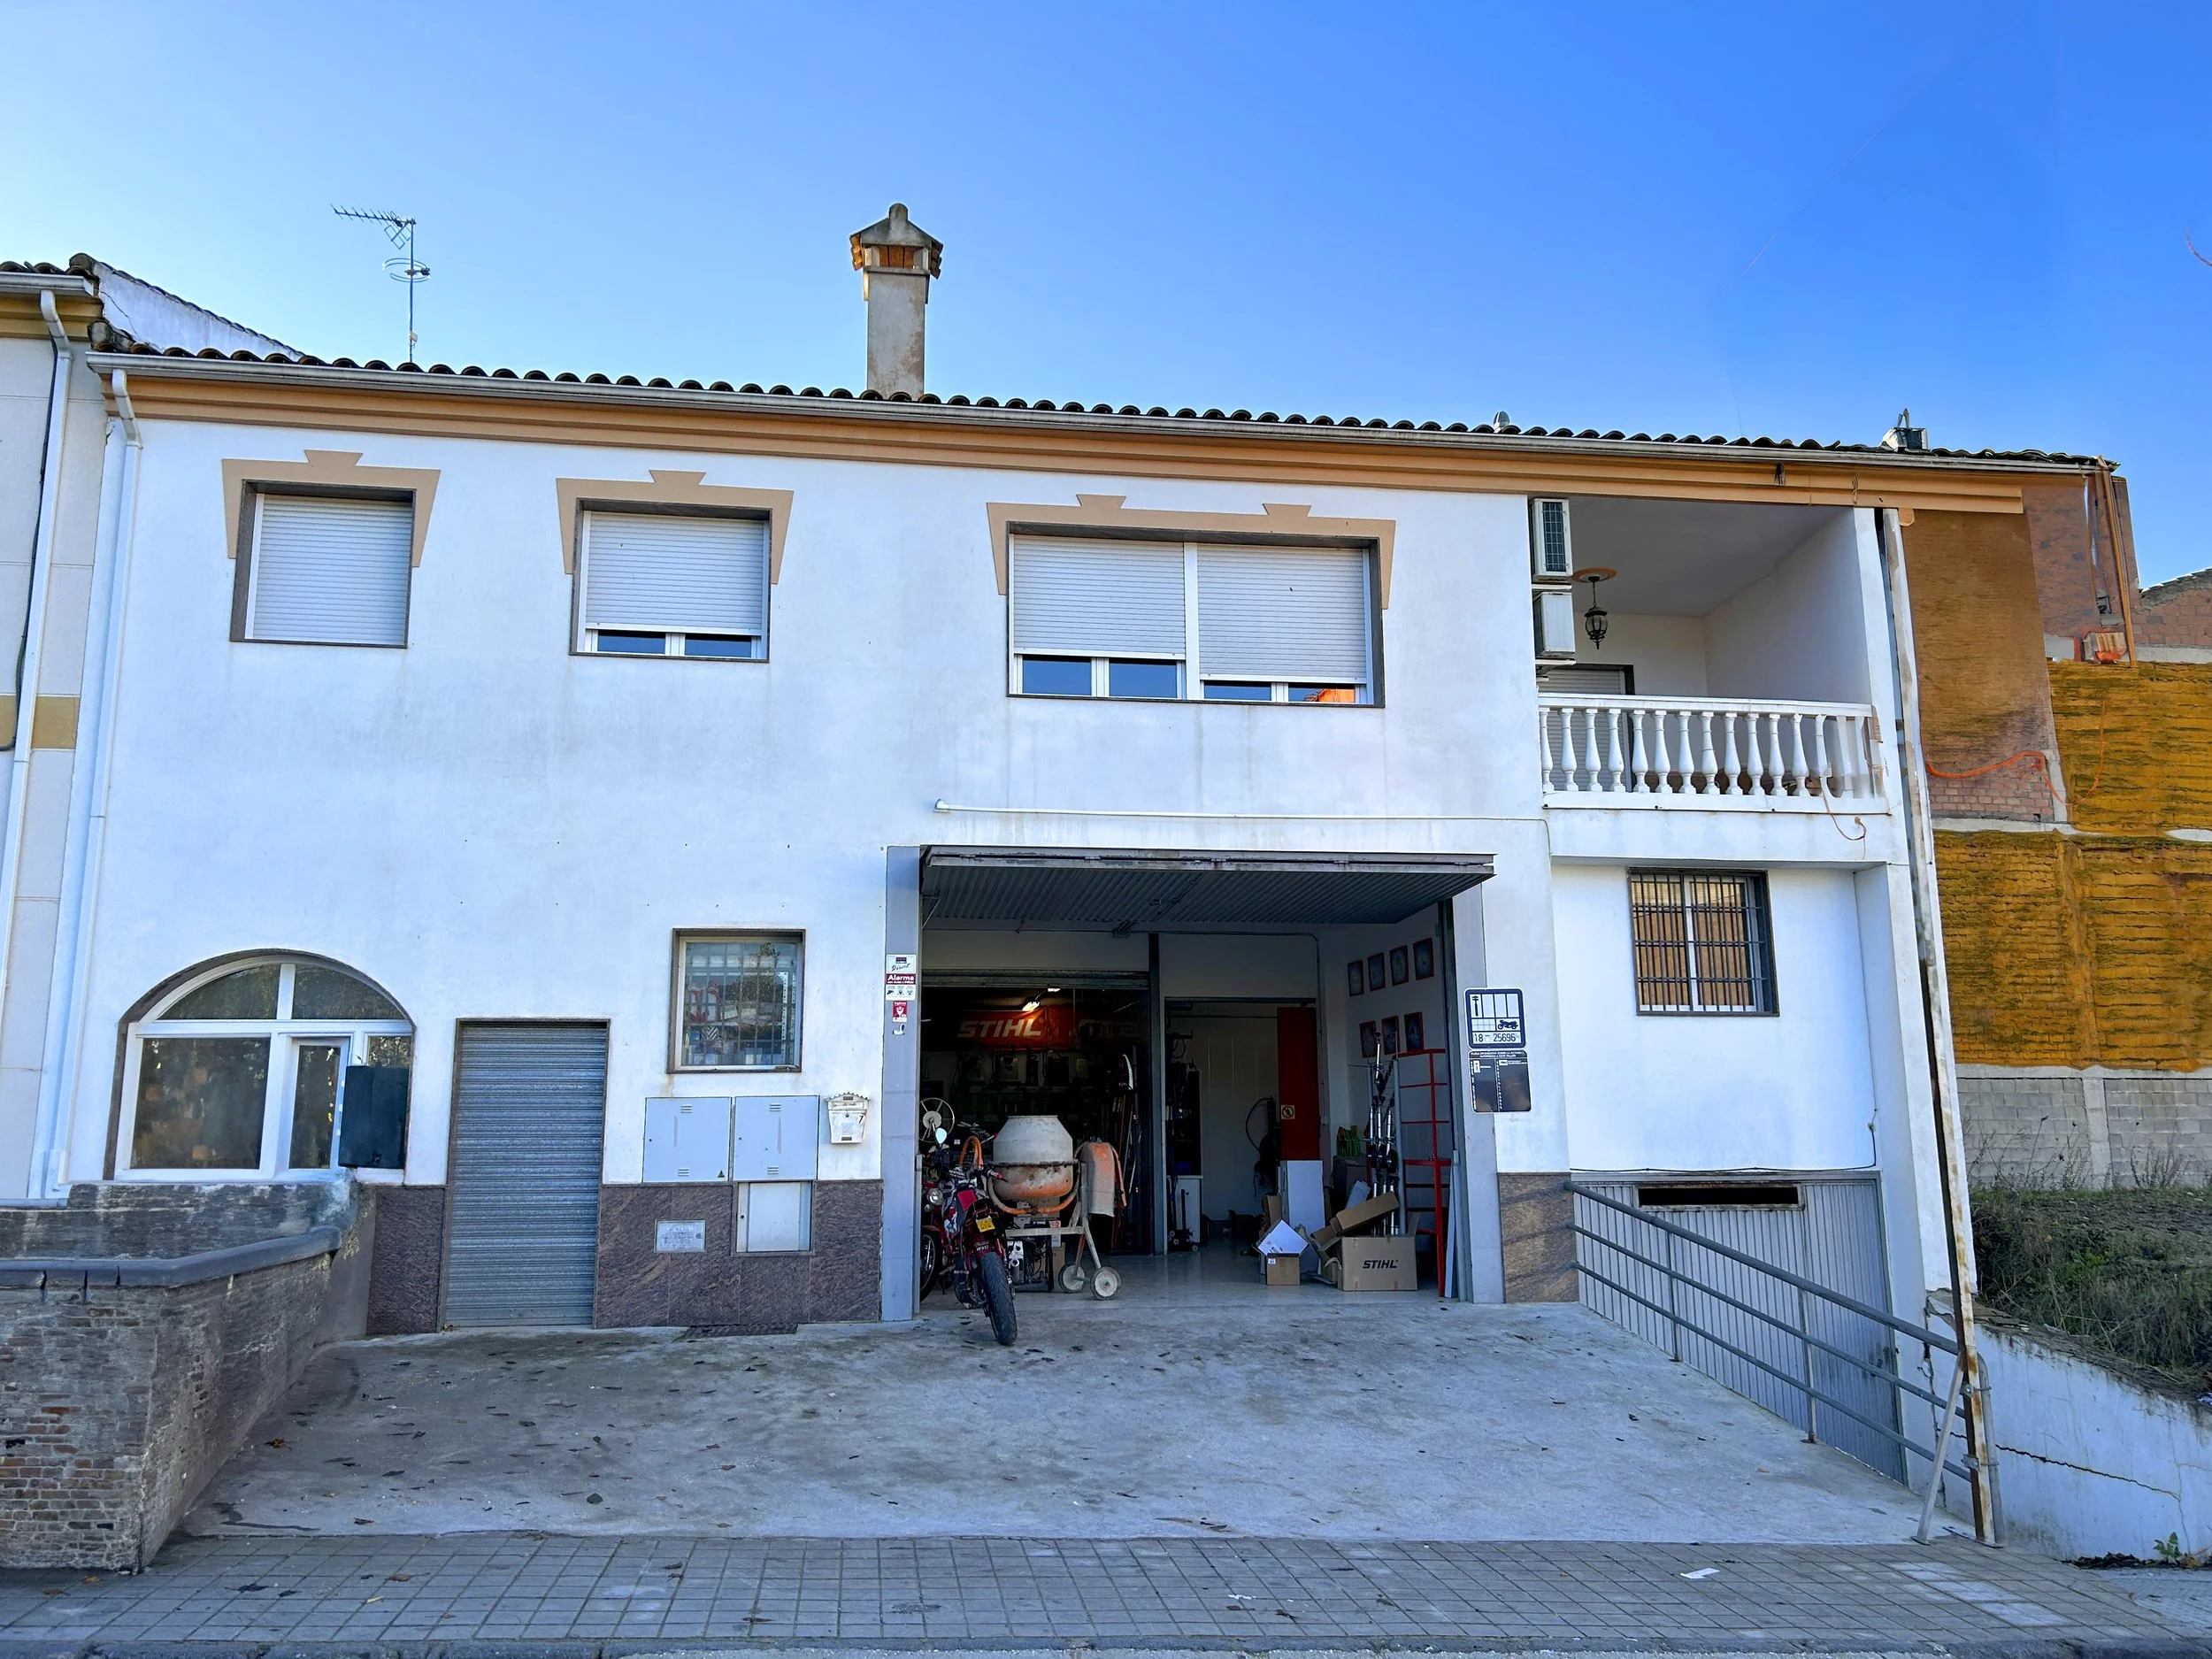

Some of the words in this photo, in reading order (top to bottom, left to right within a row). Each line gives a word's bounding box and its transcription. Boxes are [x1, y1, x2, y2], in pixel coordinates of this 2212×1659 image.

[956, 1018, 1041, 1038] STIHL
[1474, 1033, 1483, 1042] 18
[1493, 1033, 1516, 1042] 25696
[858, 1115, 864, 1124] 7
[1363, 1259, 1397, 1269] STIHL
